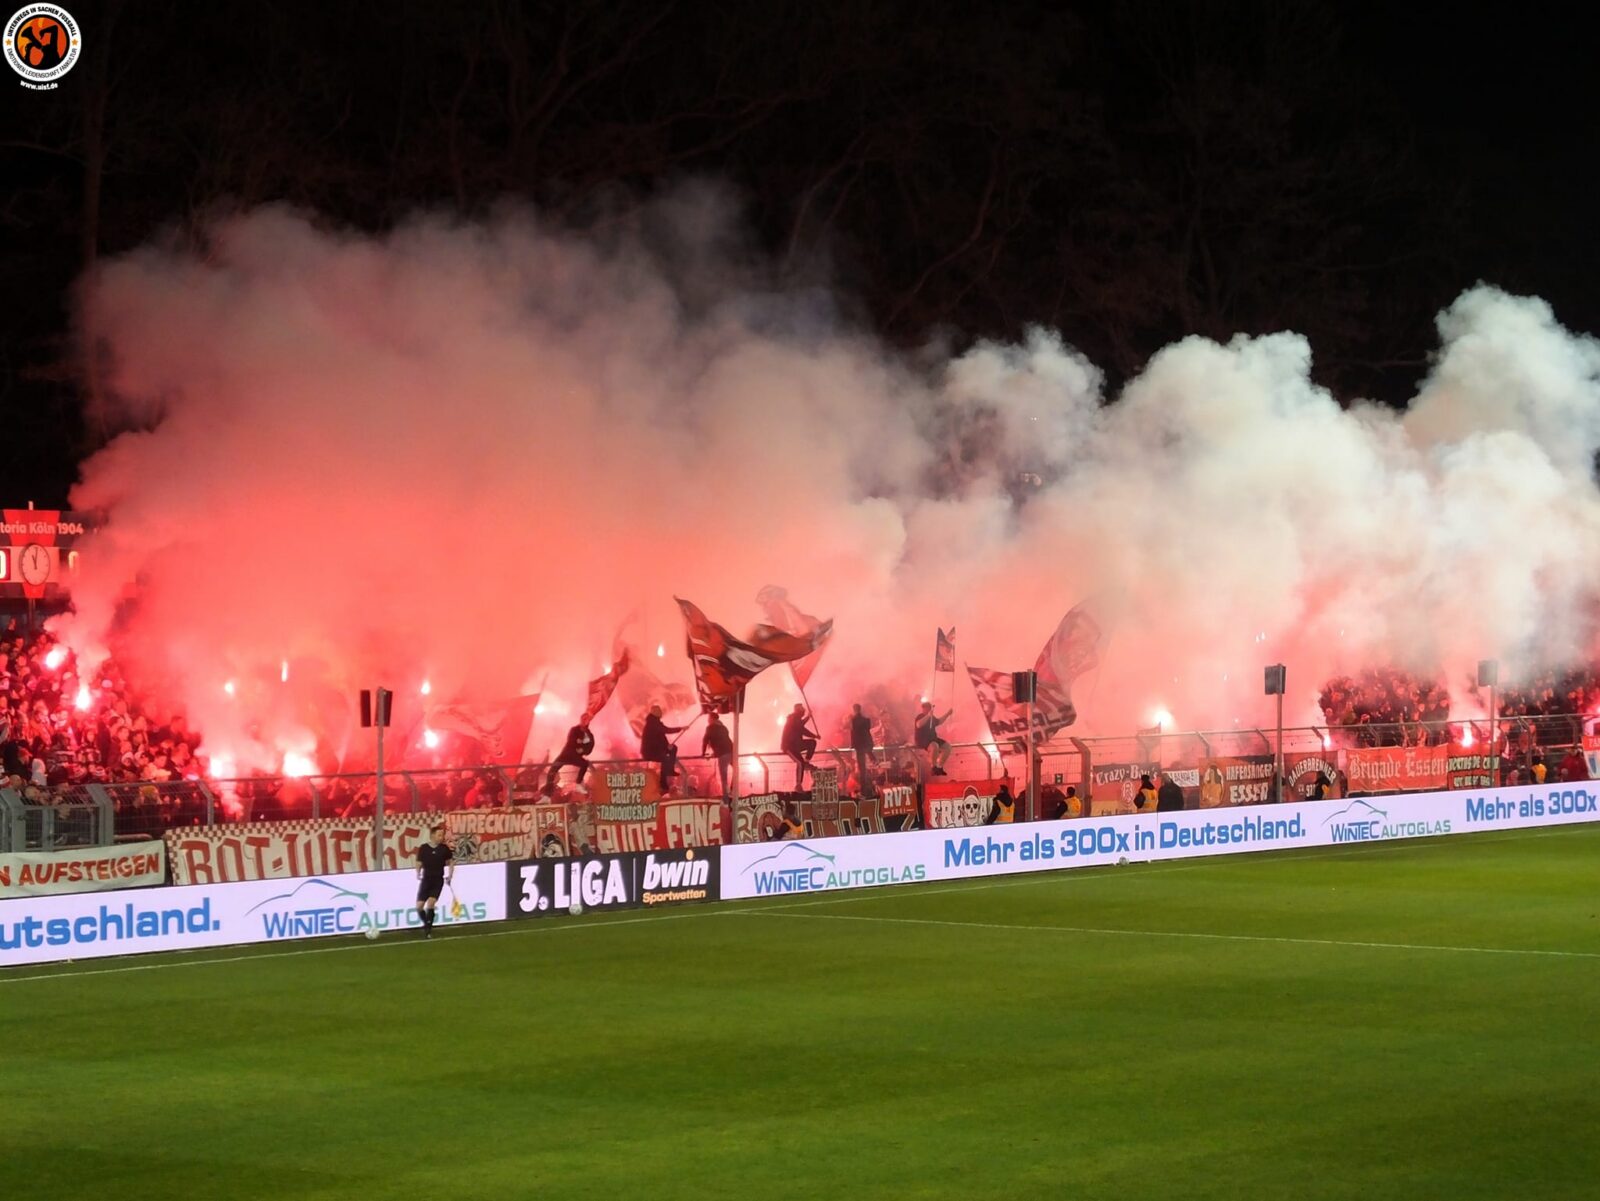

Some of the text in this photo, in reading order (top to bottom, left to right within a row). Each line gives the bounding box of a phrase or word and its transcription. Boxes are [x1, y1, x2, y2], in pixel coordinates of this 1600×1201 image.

[30, 522, 55, 534] Köln
[57, 523, 84, 534] 1904
[1349, 753, 1401, 786] Brigade
[1405, 751, 1444, 778] Essen
[882, 785, 913, 808] RVT
[1229, 782, 1270, 804] ESSEN
[1466, 789, 1597, 822] Mehr als 300x
[449, 811, 532, 835] WRECKING
[538, 810, 564, 829] LPL
[665, 803, 724, 850] FANS
[1380, 819, 1452, 839] AUTOGLAS
[479, 836, 528, 861] CREW
[944, 812, 1306, 868] Mehr als 300x in Deutschland.
[18, 853, 160, 886] AUFSTEIGEN
[642, 850, 709, 890] bwin
[826, 864, 926, 889] AUTOGLAS
[519, 859, 627, 912] 3. LIGA
[642, 889, 707, 905] Sportwetten
